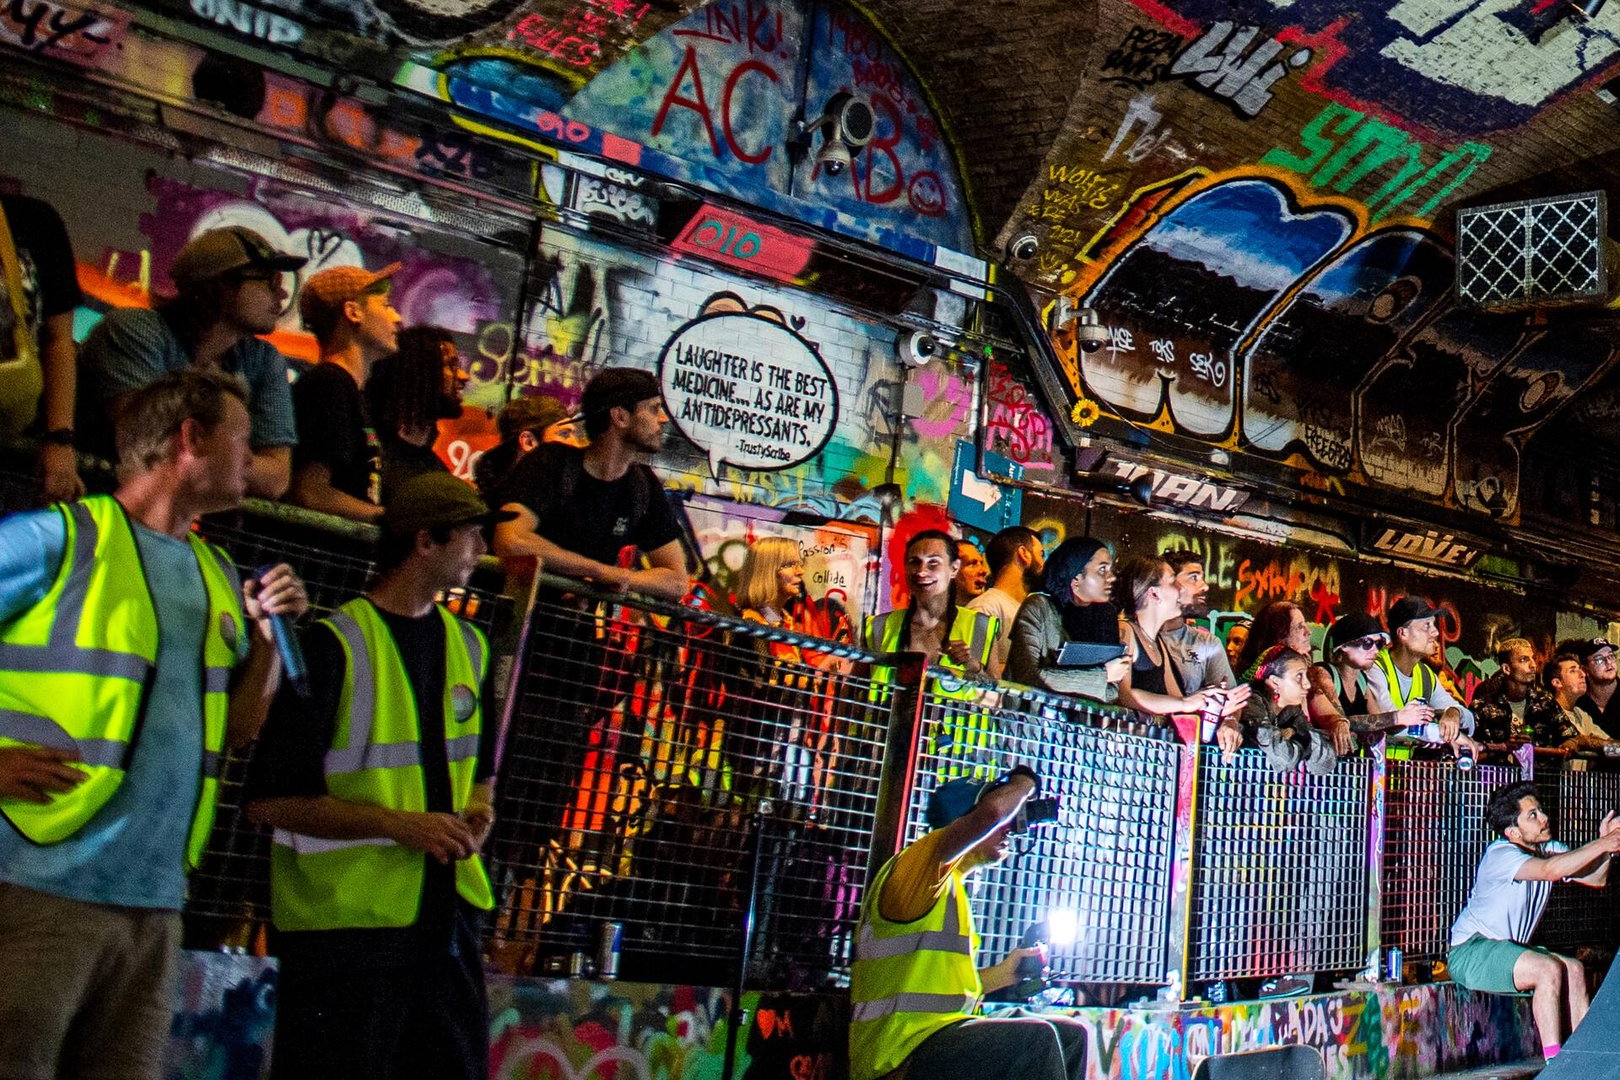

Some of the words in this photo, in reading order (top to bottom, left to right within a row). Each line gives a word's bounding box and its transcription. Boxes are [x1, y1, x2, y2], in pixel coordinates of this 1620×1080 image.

[672, 368, 750, 407] MEDICINE...
[754, 388, 773, 412] AS
[775, 392, 800, 419] ARE
[803, 400, 826, 424] MY
[676, 342, 748, 381] LAUGHTER
[751, 360, 764, 383] IS
[768, 364, 792, 391] THE
[795, 371, 828, 401] BEST
[681, 397, 811, 447] ANTIDEPRESSANTS.
